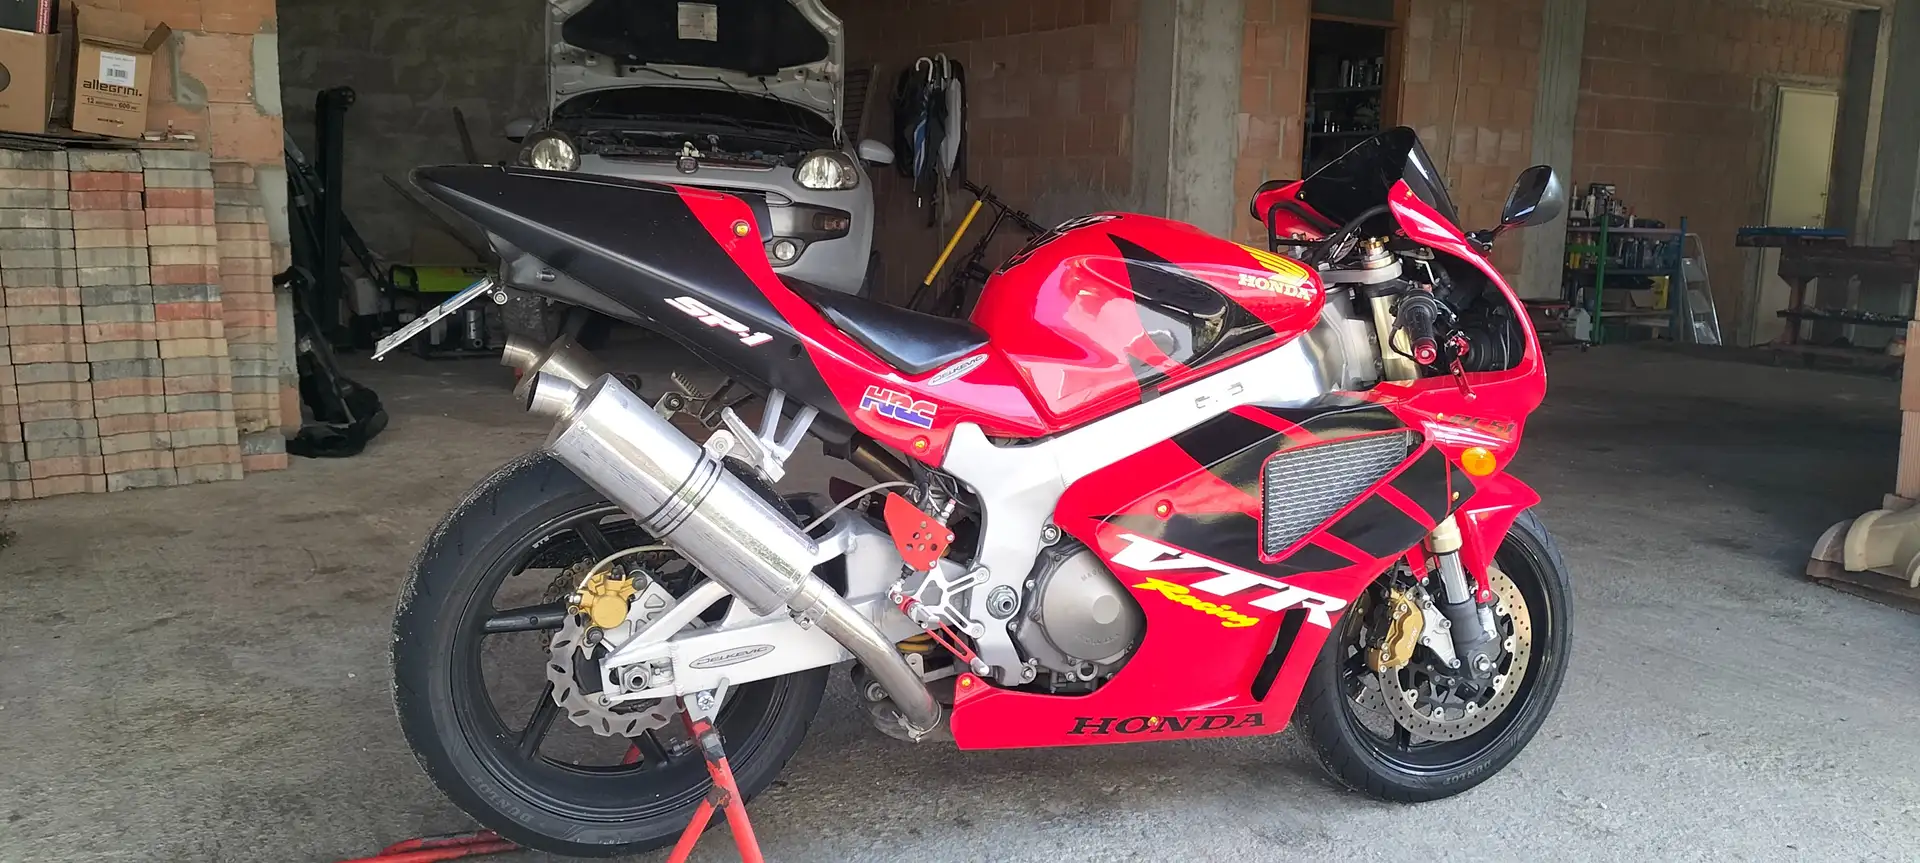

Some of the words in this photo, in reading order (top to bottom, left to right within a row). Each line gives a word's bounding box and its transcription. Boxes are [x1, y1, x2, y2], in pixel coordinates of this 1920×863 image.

[1237, 273, 1311, 301] HONDA
[663, 296, 774, 347] SP-1
[858, 384, 938, 430] HRC
[1109, 533, 1348, 630] VTR
[1131, 576, 1260, 628] Racing
[1066, 712, 1266, 736] HONDA
